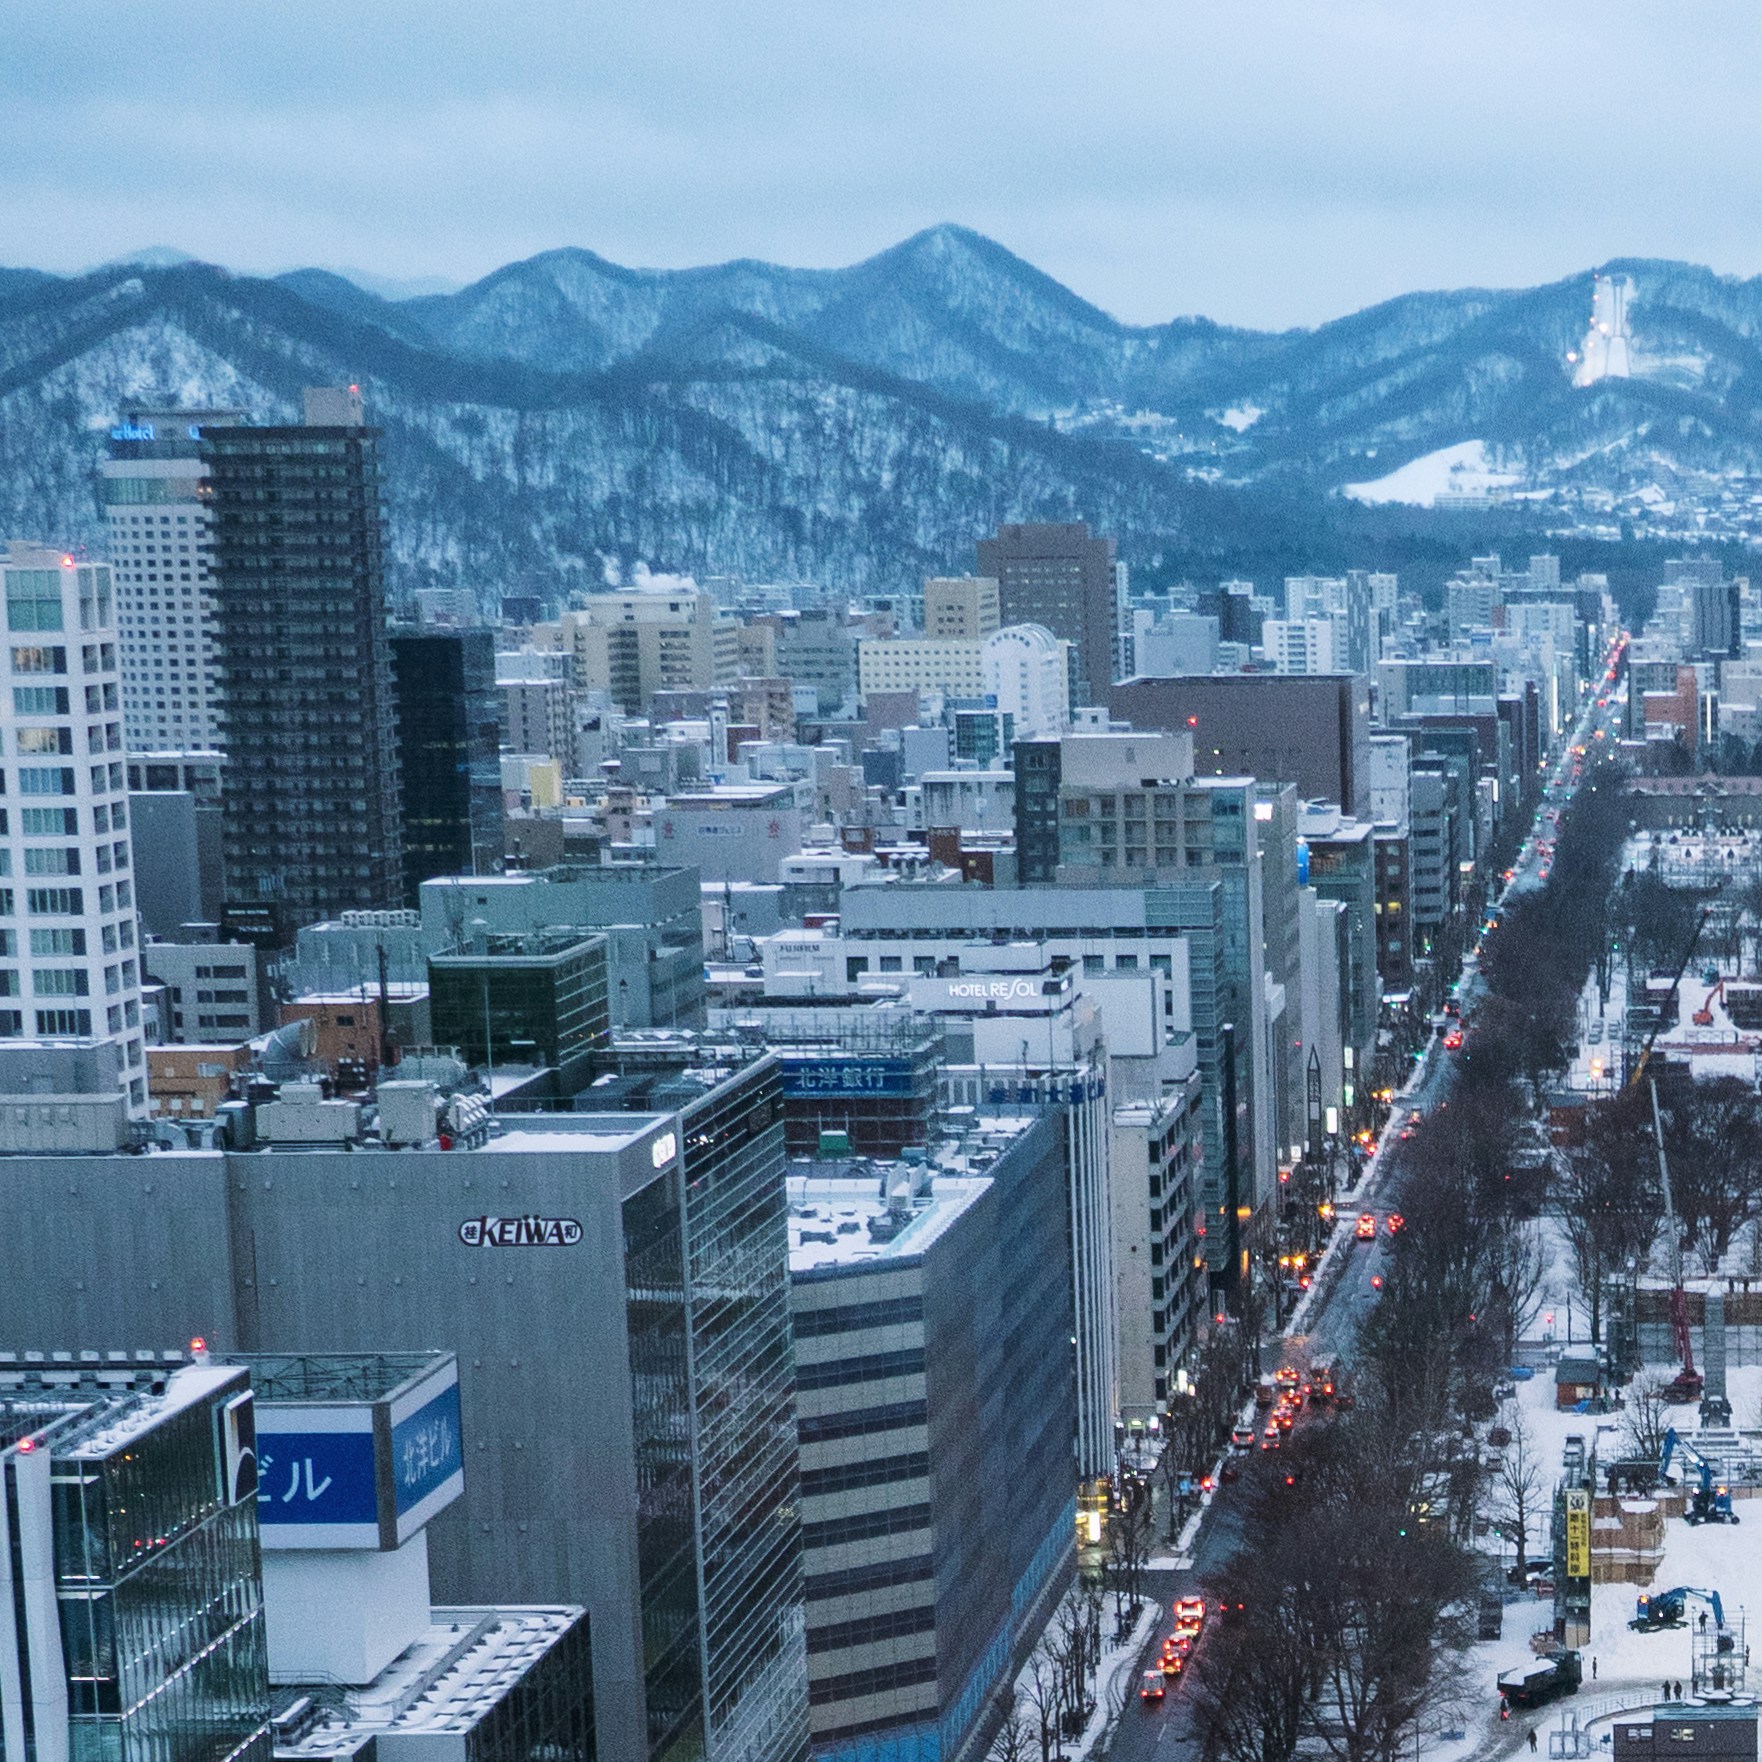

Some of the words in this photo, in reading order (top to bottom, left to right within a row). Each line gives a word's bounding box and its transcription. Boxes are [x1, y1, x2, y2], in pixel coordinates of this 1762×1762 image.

[949, 984, 988, 997] HOTEL
[990, 979, 1038, 1000] RESOL
[796, 1067, 885, 1088] 北洋銀行
[403, 1416, 451, 1487] 北洋ビル
